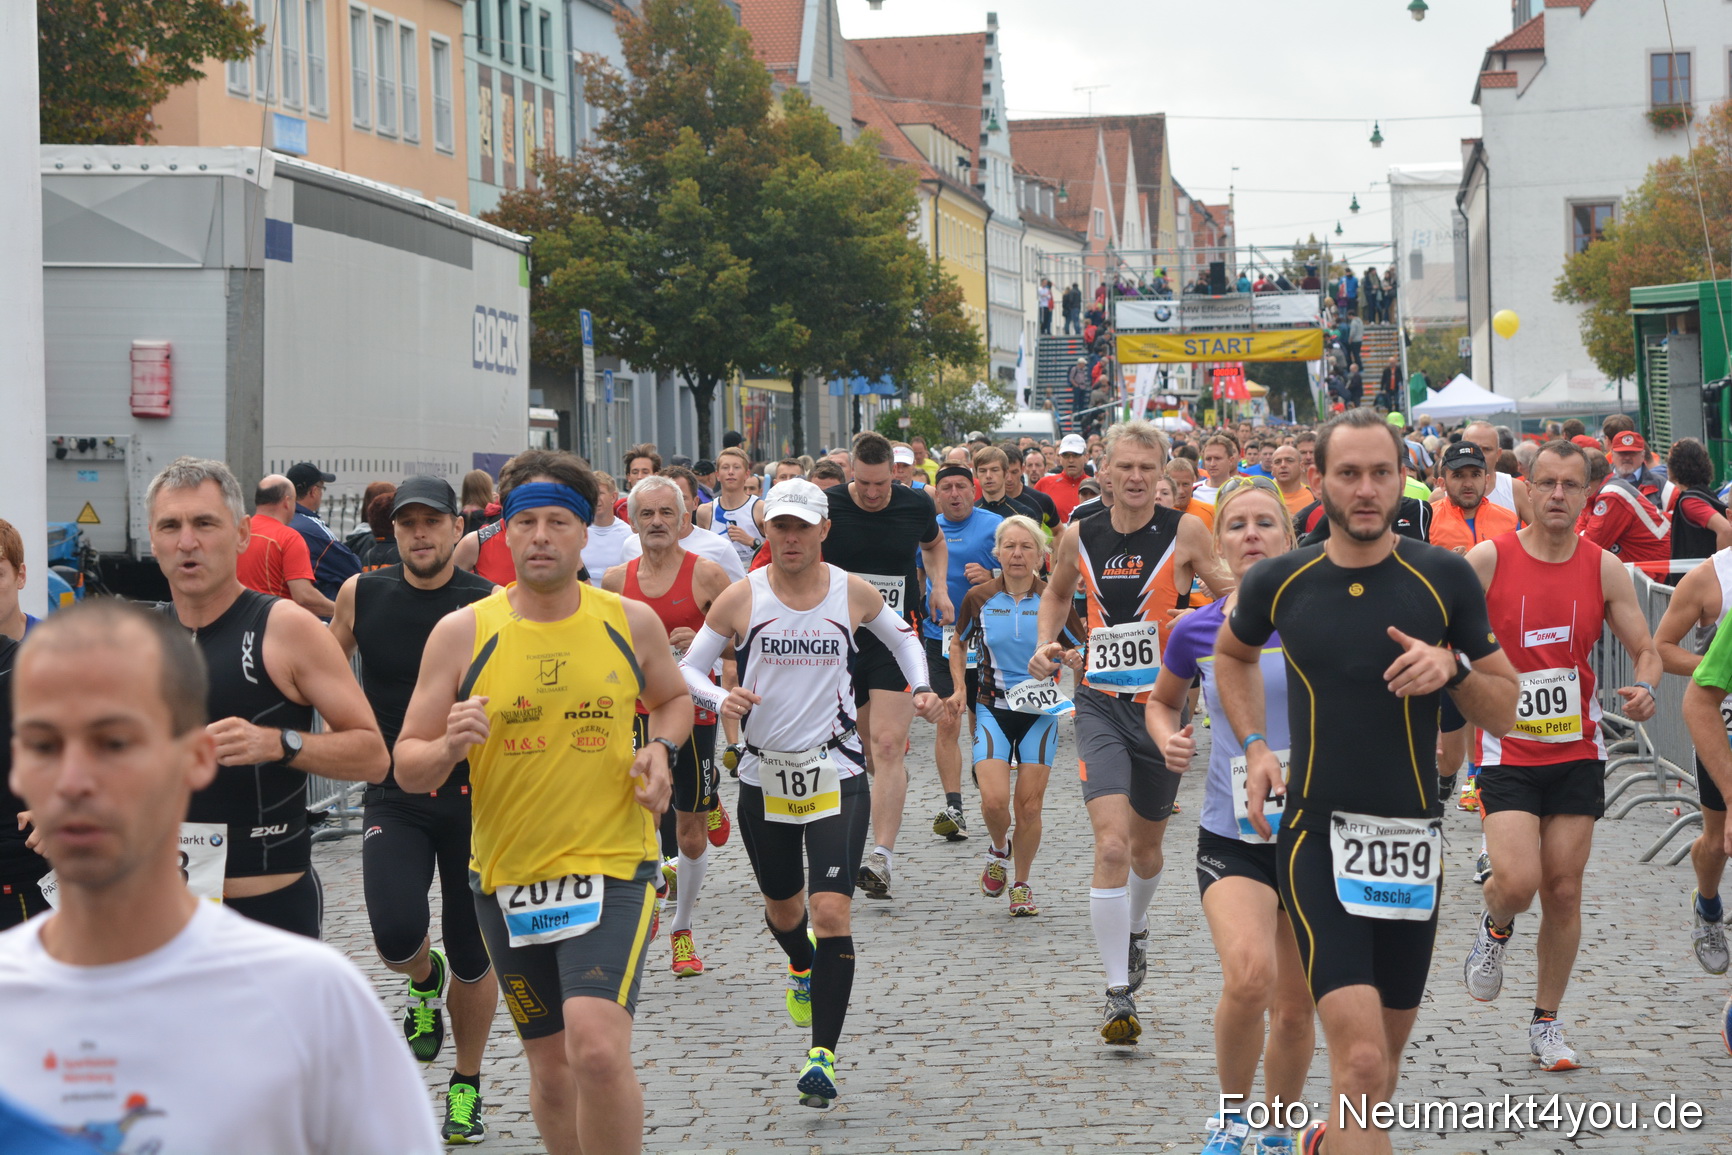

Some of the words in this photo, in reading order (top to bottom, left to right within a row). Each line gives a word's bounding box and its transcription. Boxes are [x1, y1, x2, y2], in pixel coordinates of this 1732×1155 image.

[473, 304, 519, 376] BOCK
[1184, 337, 1255, 356] START
[869, 579, 896, 587] Neumarkt
[1109, 629, 1145, 639] Neumarkt
[1536, 632, 1557, 641] DEHN
[761, 637, 840, 656] ERDINGER
[761, 657, 840, 666] ALKOHOLFREI
[1096, 639, 1153, 670] 3396
[1529, 675, 1566, 686] Neumarkt
[1007, 687, 1025, 700] PARTL
[571, 725, 610, 738] PIZZERIA
[1546, 722, 1572, 733] Peter
[503, 739, 516, 751] M
[520, 737, 533, 750] &
[537, 736, 546, 749] S
[576, 737, 606, 747] ELIO
[785, 755, 818, 768] Neumarkt
[702, 759, 711, 796] SKINS
[776, 766, 820, 797] 187
[788, 802, 816, 814] Klaus
[250, 823, 288, 838] 2XU
[1376, 827, 1425, 837] Neumarkt
[1344, 839, 1431, 879] 2059
[509, 874, 593, 908] 2078
[1364, 886, 1411, 905] Sascha
[531, 912, 569, 931] Alfred
[510, 980, 541, 1013] Run!
